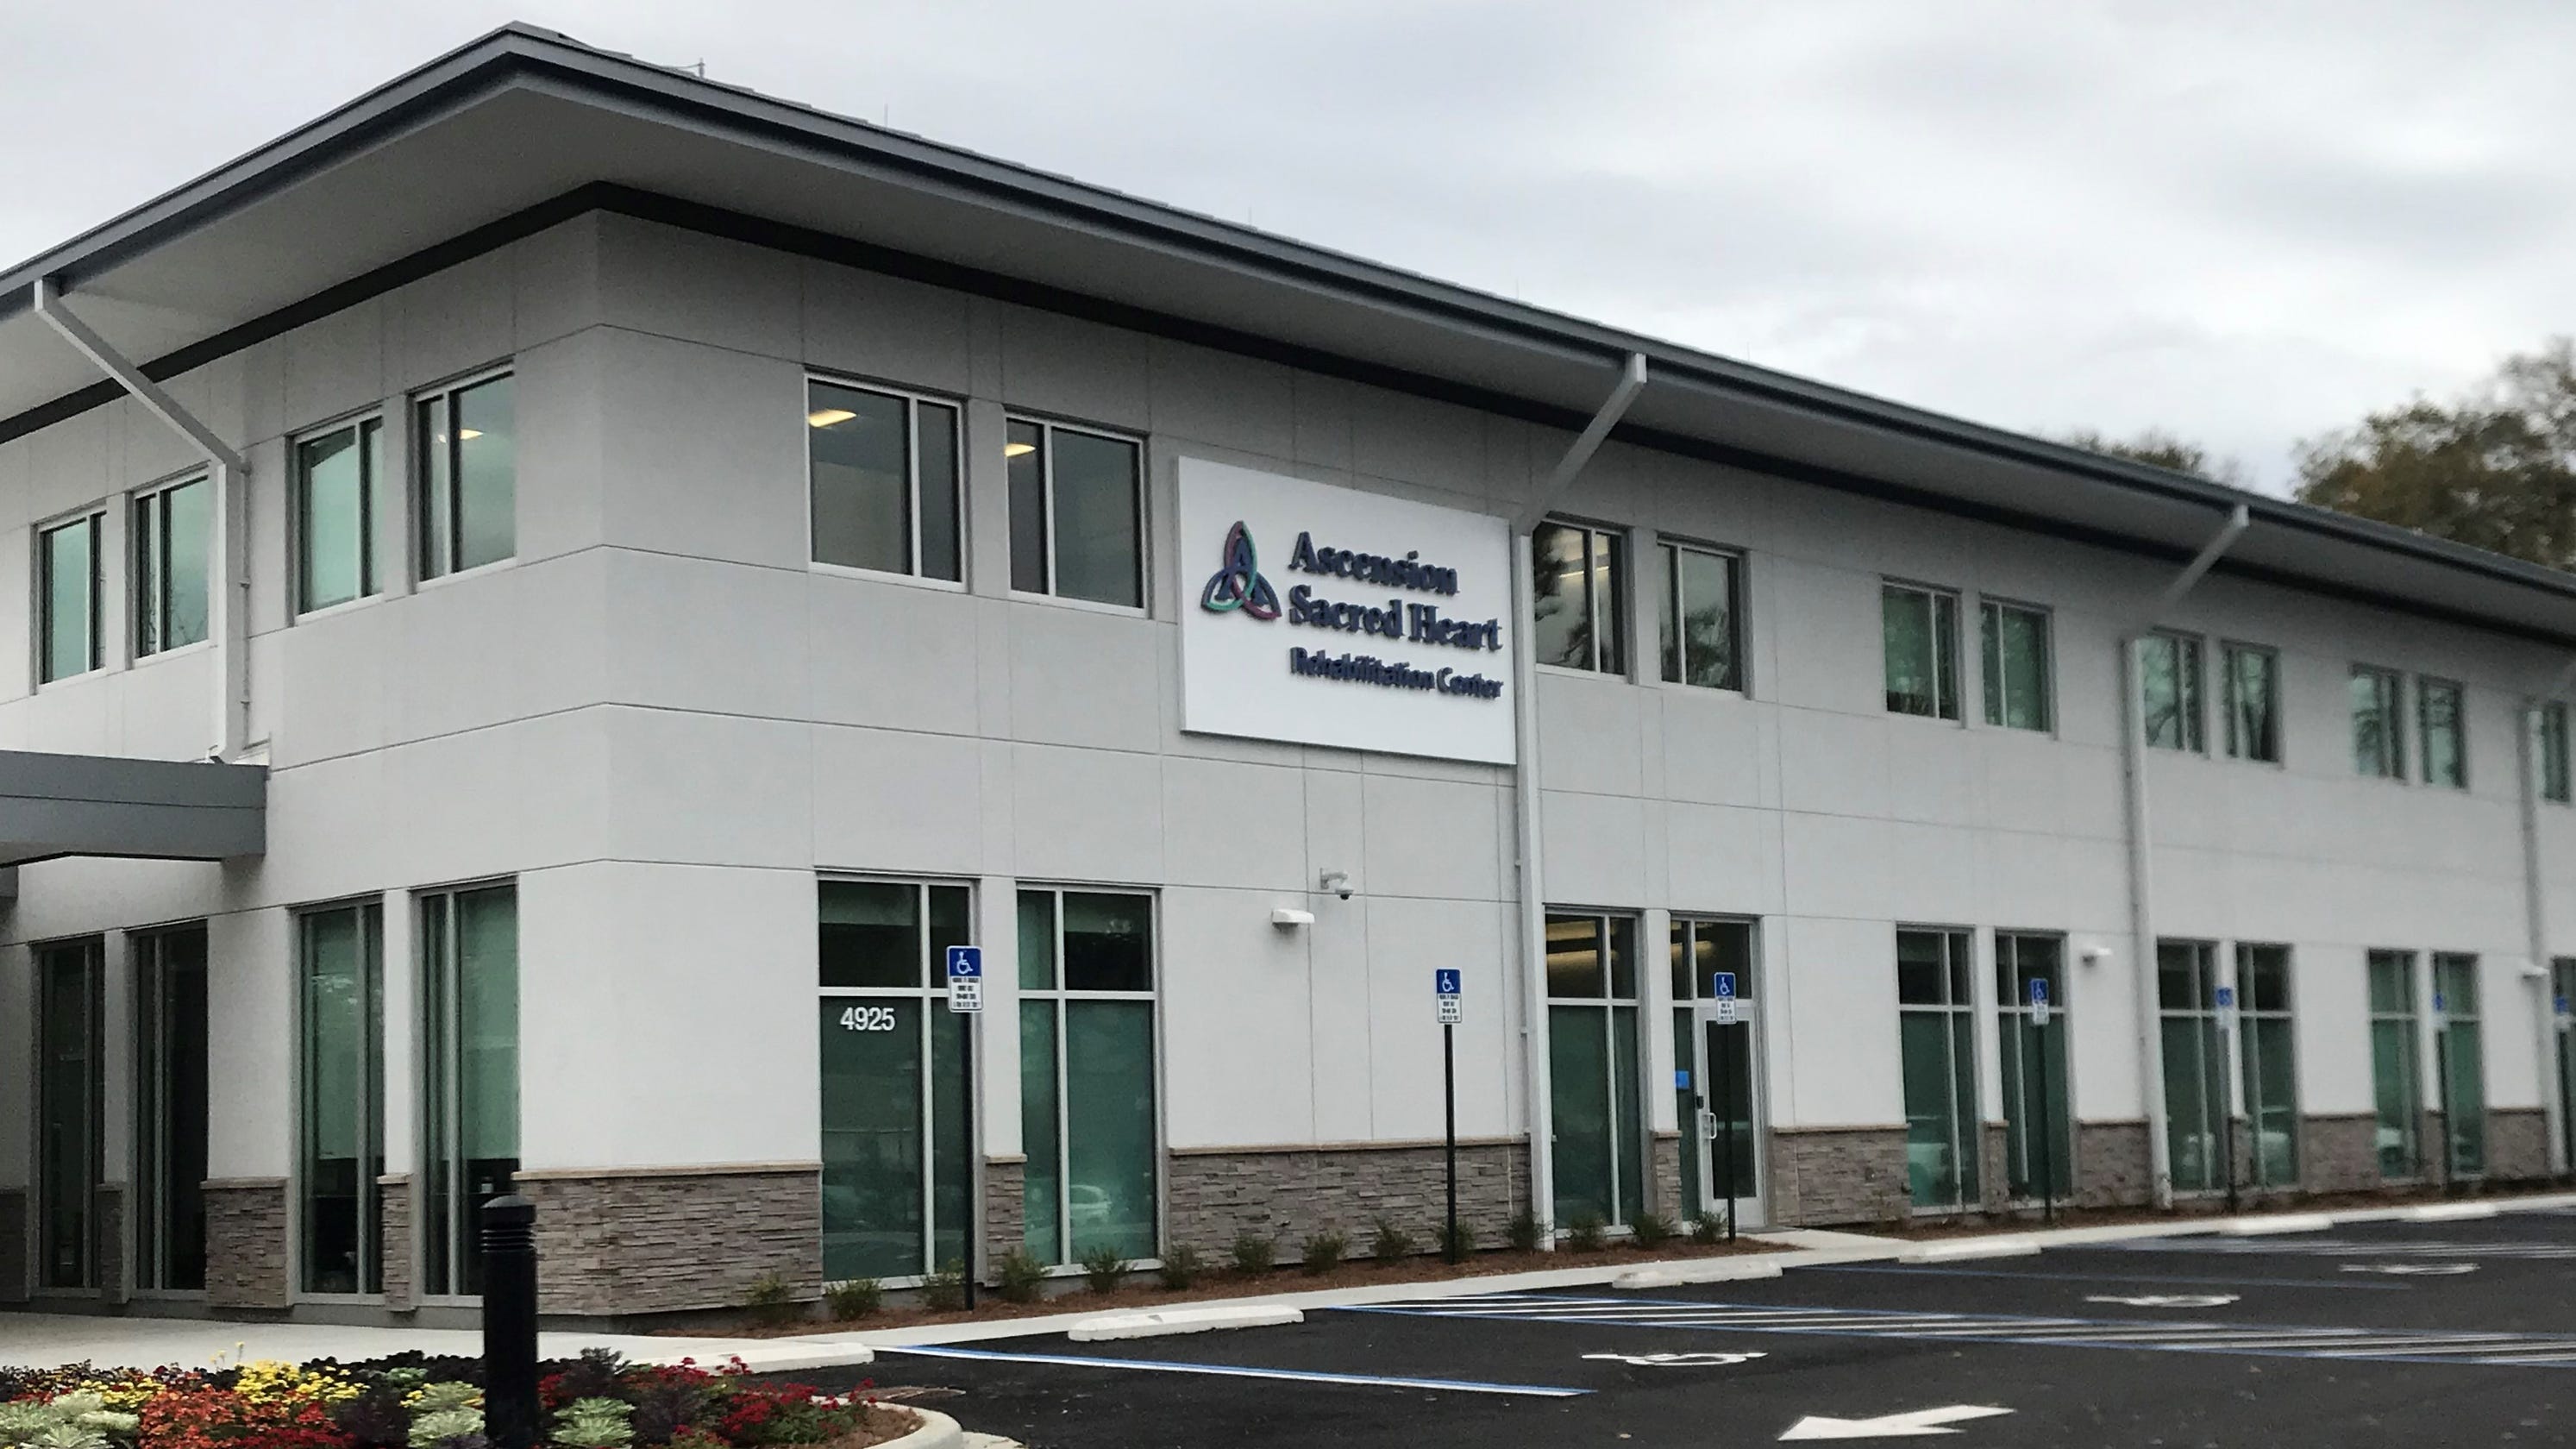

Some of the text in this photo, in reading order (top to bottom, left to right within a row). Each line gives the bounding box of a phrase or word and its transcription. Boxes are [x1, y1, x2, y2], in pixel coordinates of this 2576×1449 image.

[1288, 531, 1460, 596] Ascension
[1288, 584, 1503, 652] Sacred Heart
[1290, 646, 1504, 699] Rehabilitation Center
[840, 1007, 896, 1031] 4925
